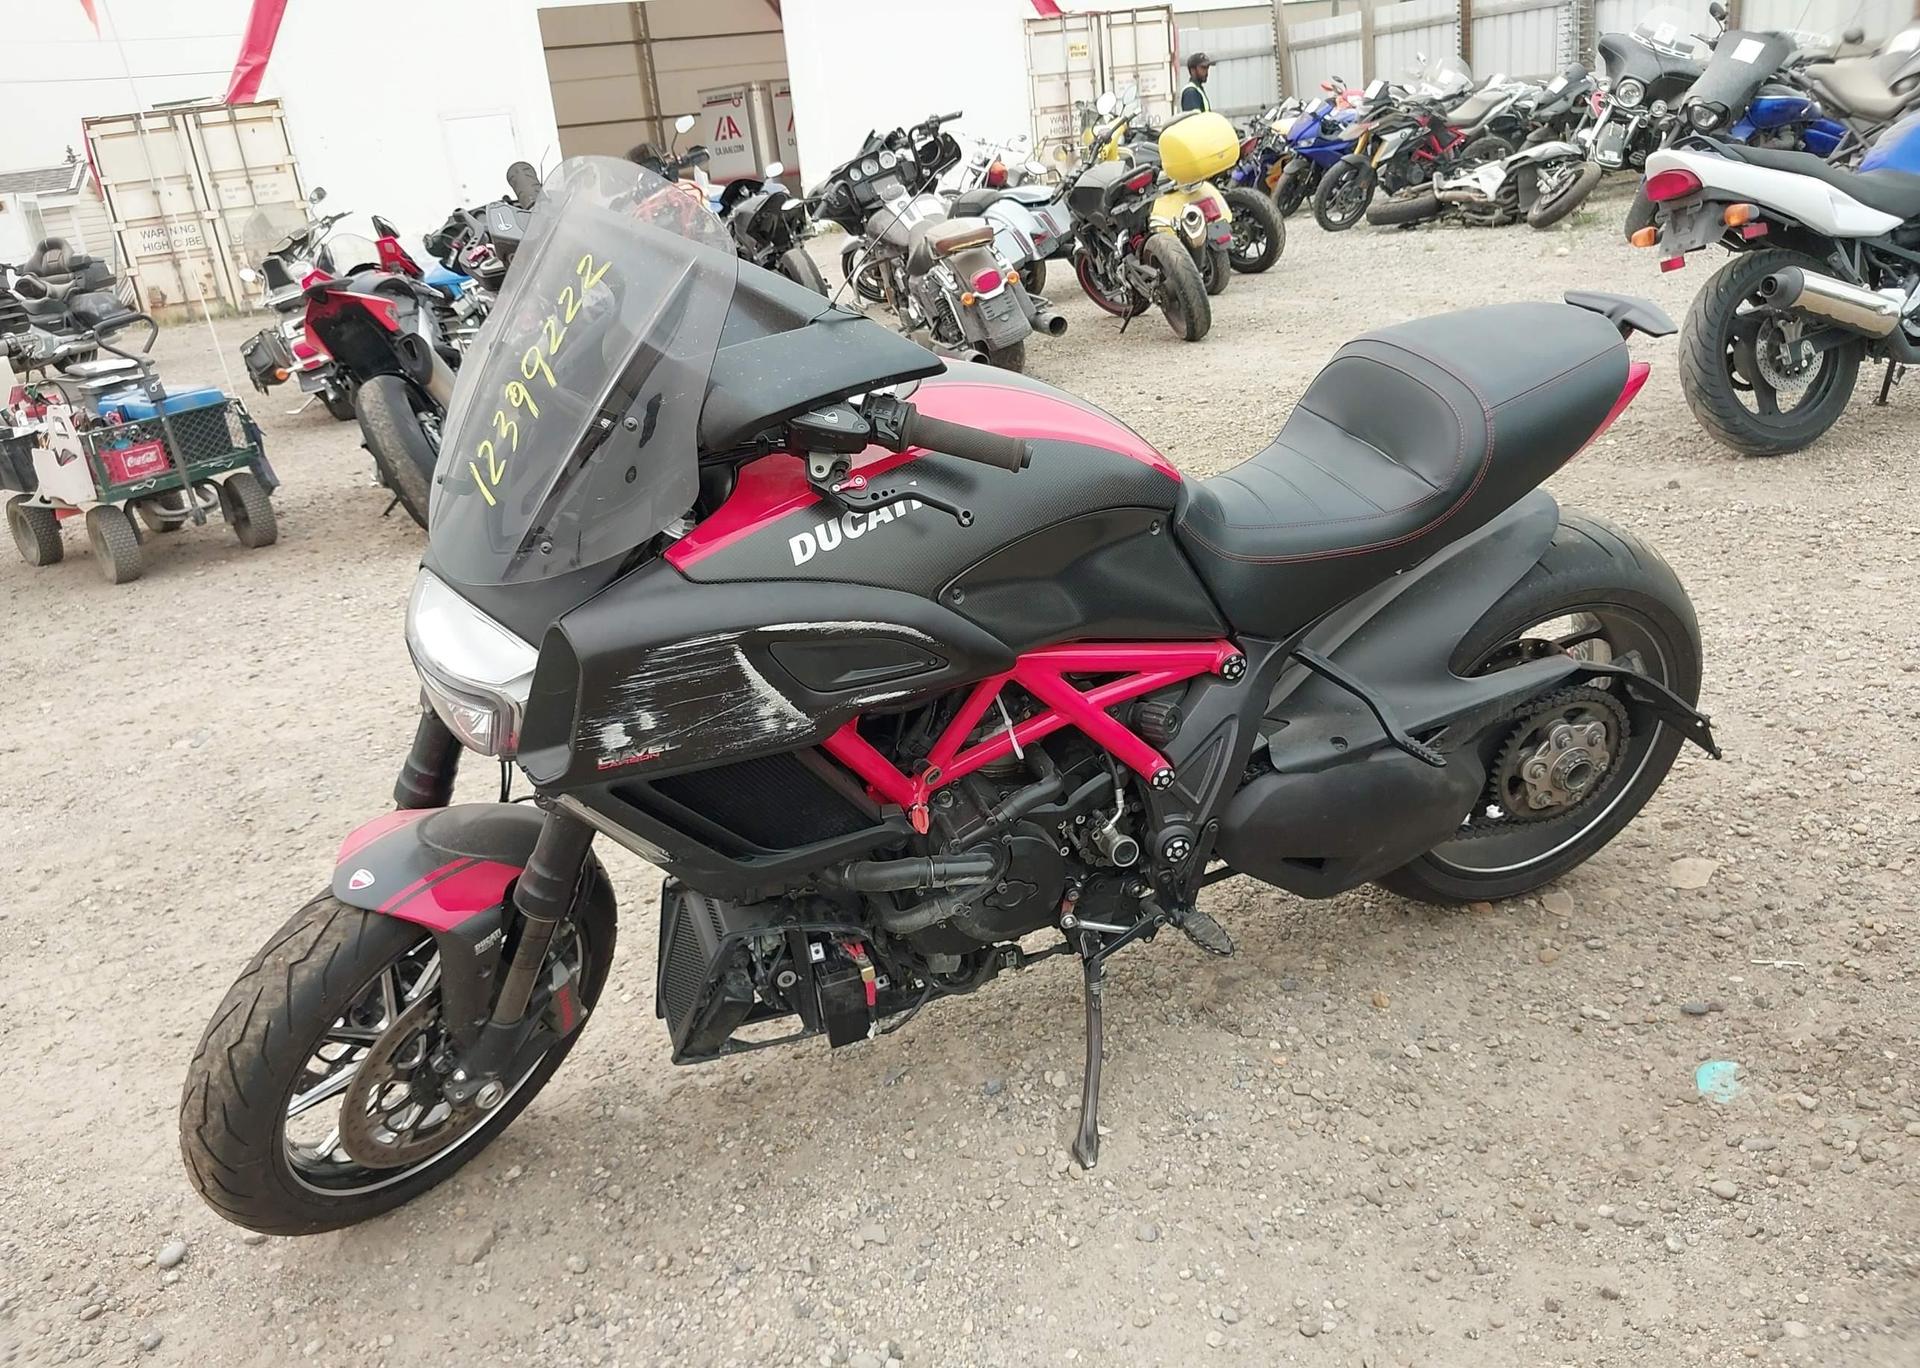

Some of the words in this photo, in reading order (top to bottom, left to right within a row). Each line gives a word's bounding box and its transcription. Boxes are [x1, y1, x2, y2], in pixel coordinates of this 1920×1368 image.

[1049, 112, 1081, 124] WARNI
[139, 224, 196, 239] WARNNG
[142, 239, 170, 252] HIGH
[468, 254, 612, 506] 12399222
[597, 742, 682, 765] DAVEL
